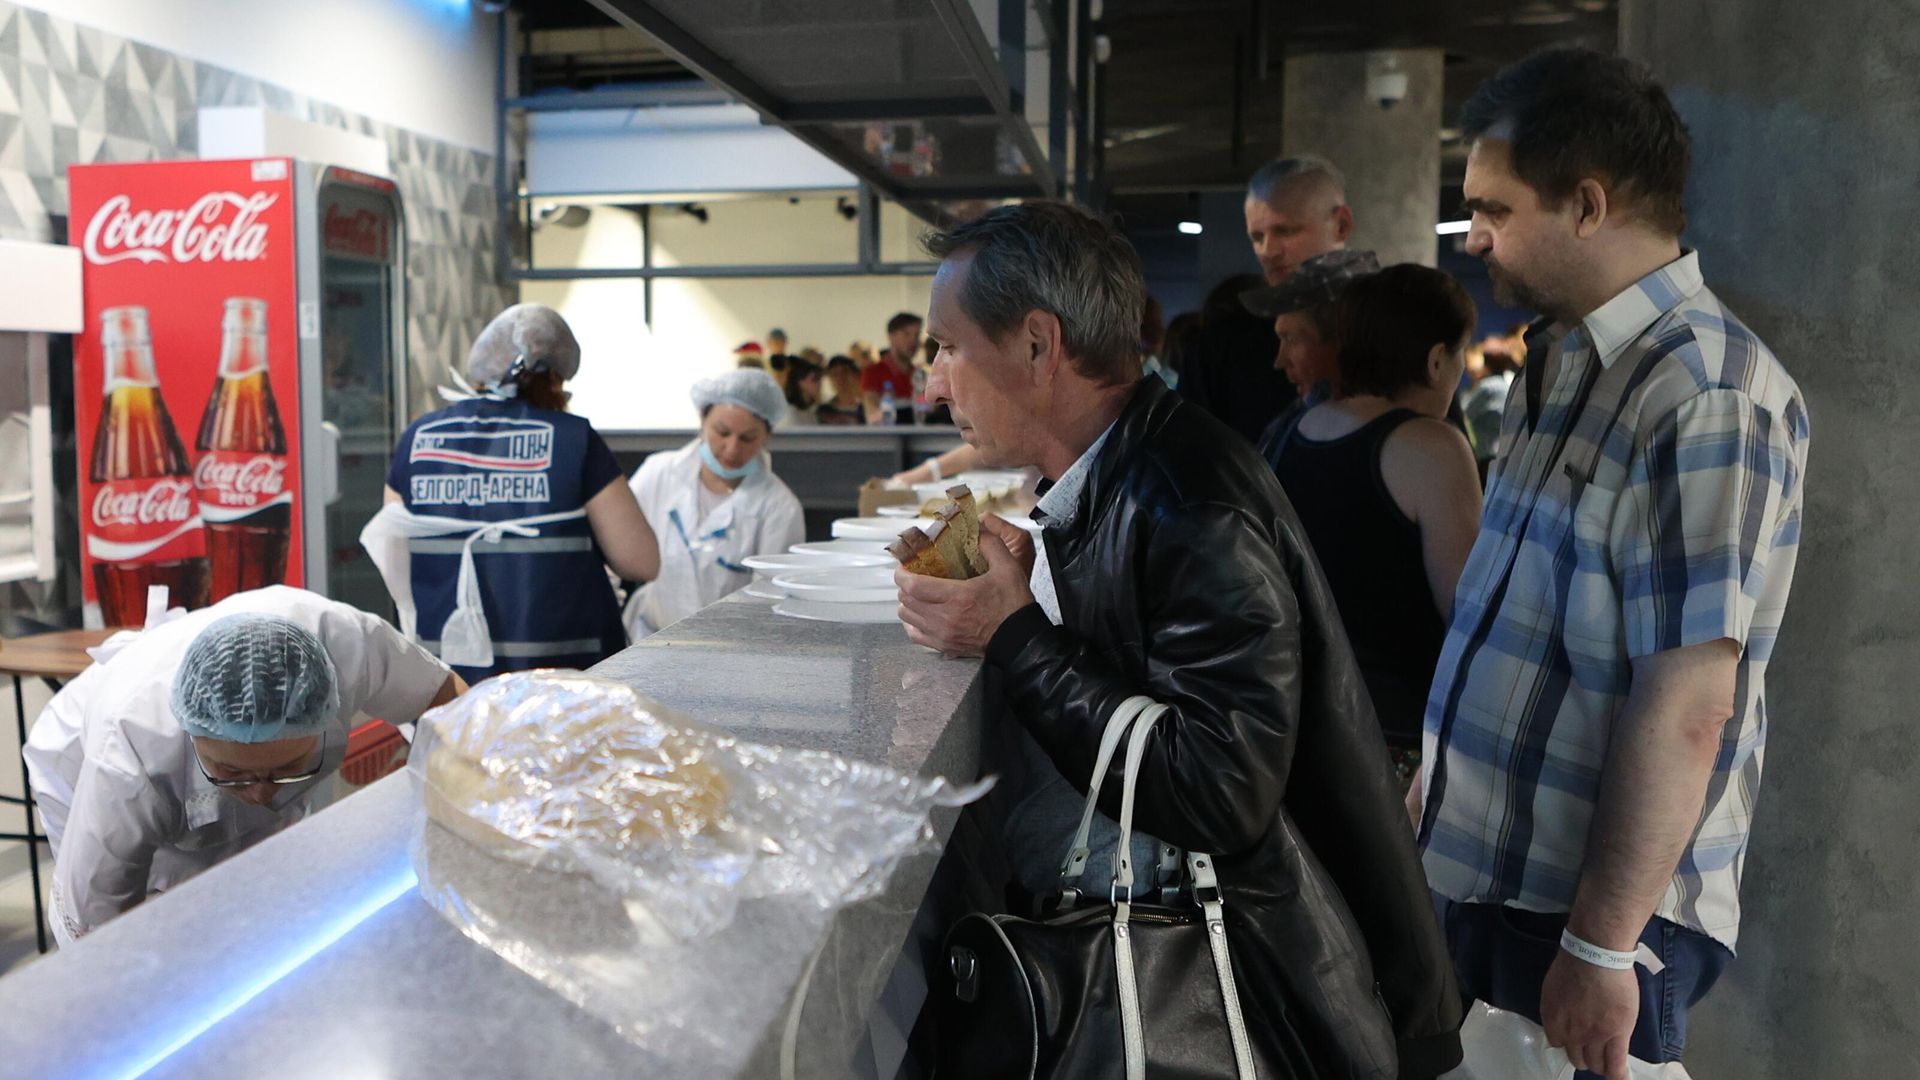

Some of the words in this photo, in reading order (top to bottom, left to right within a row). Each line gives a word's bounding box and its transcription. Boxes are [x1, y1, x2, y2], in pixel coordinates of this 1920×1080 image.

[83, 191, 280, 265] Coca-Cola
[194, 454, 288, 494] Coca-Cola
[92, 480, 193, 527] Coca-Cola
